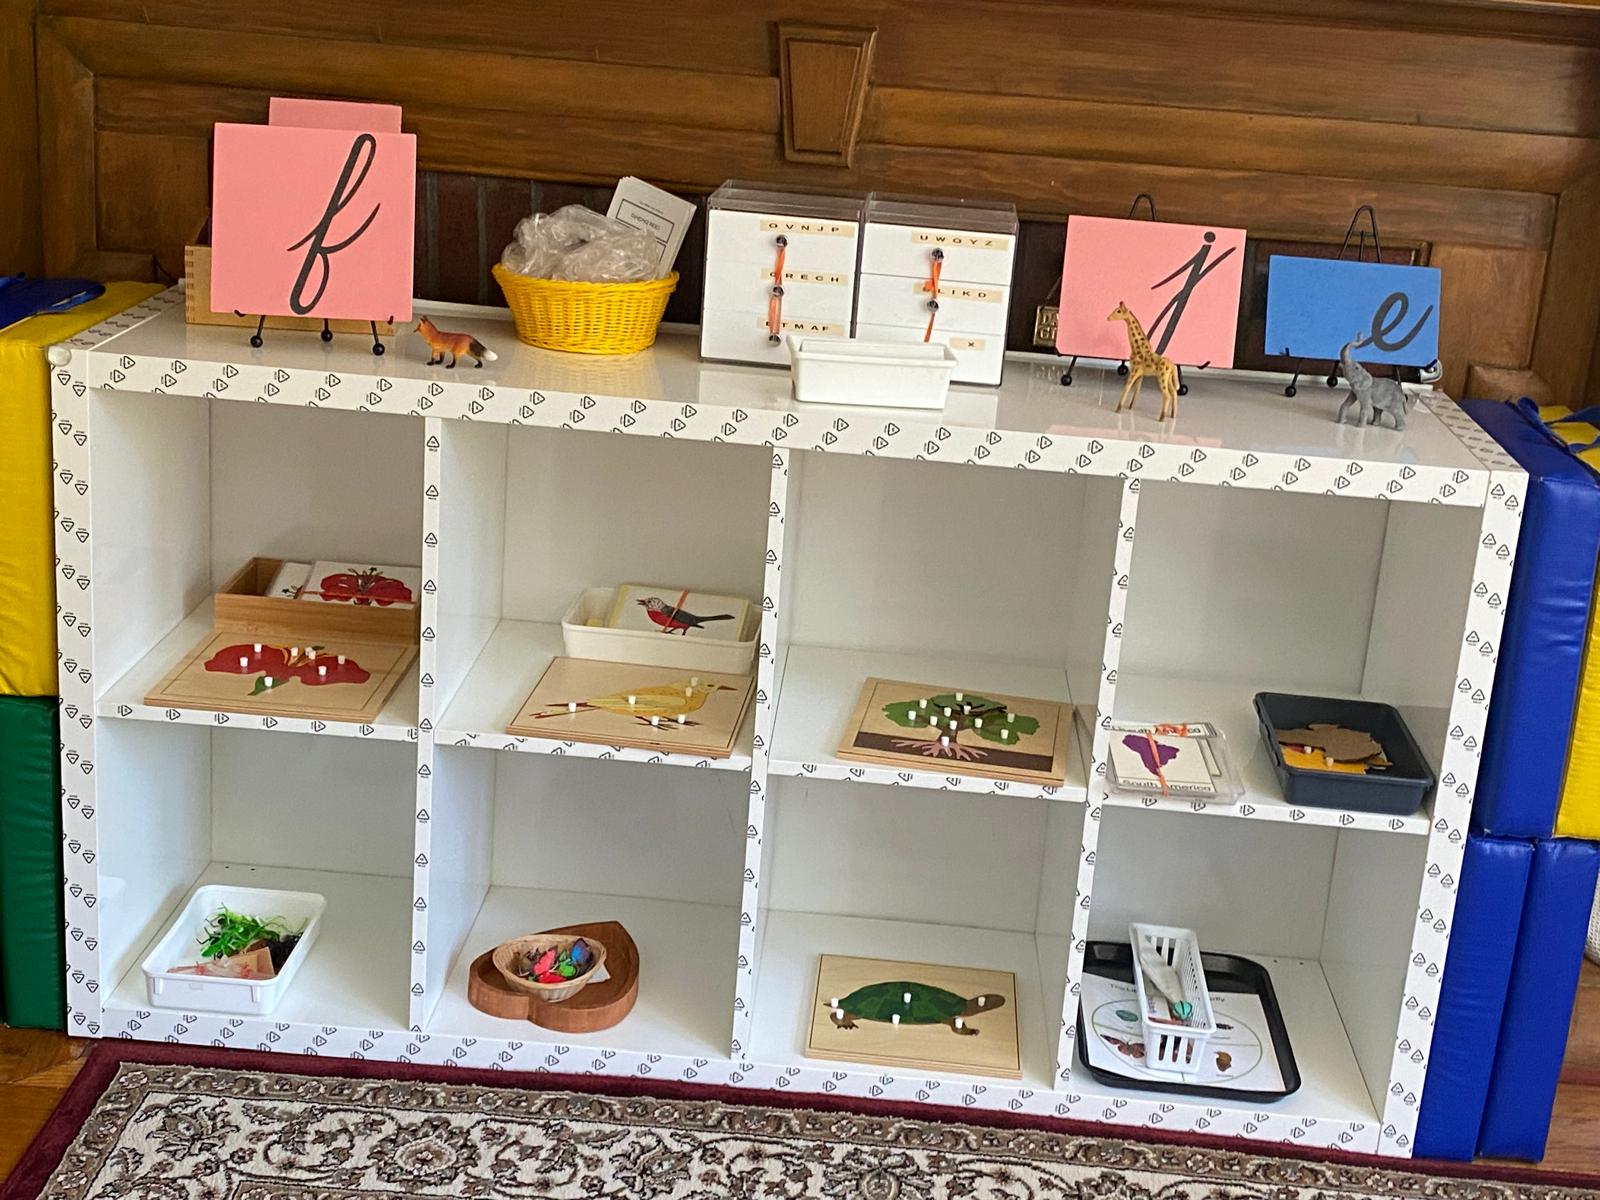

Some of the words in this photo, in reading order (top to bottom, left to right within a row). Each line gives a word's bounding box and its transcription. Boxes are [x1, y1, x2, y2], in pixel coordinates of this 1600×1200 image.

[286, 133, 381, 316] f
[1146, 231, 1236, 357] j
[1354, 292, 1434, 352] e
[1165, 782, 1211, 792] merica
